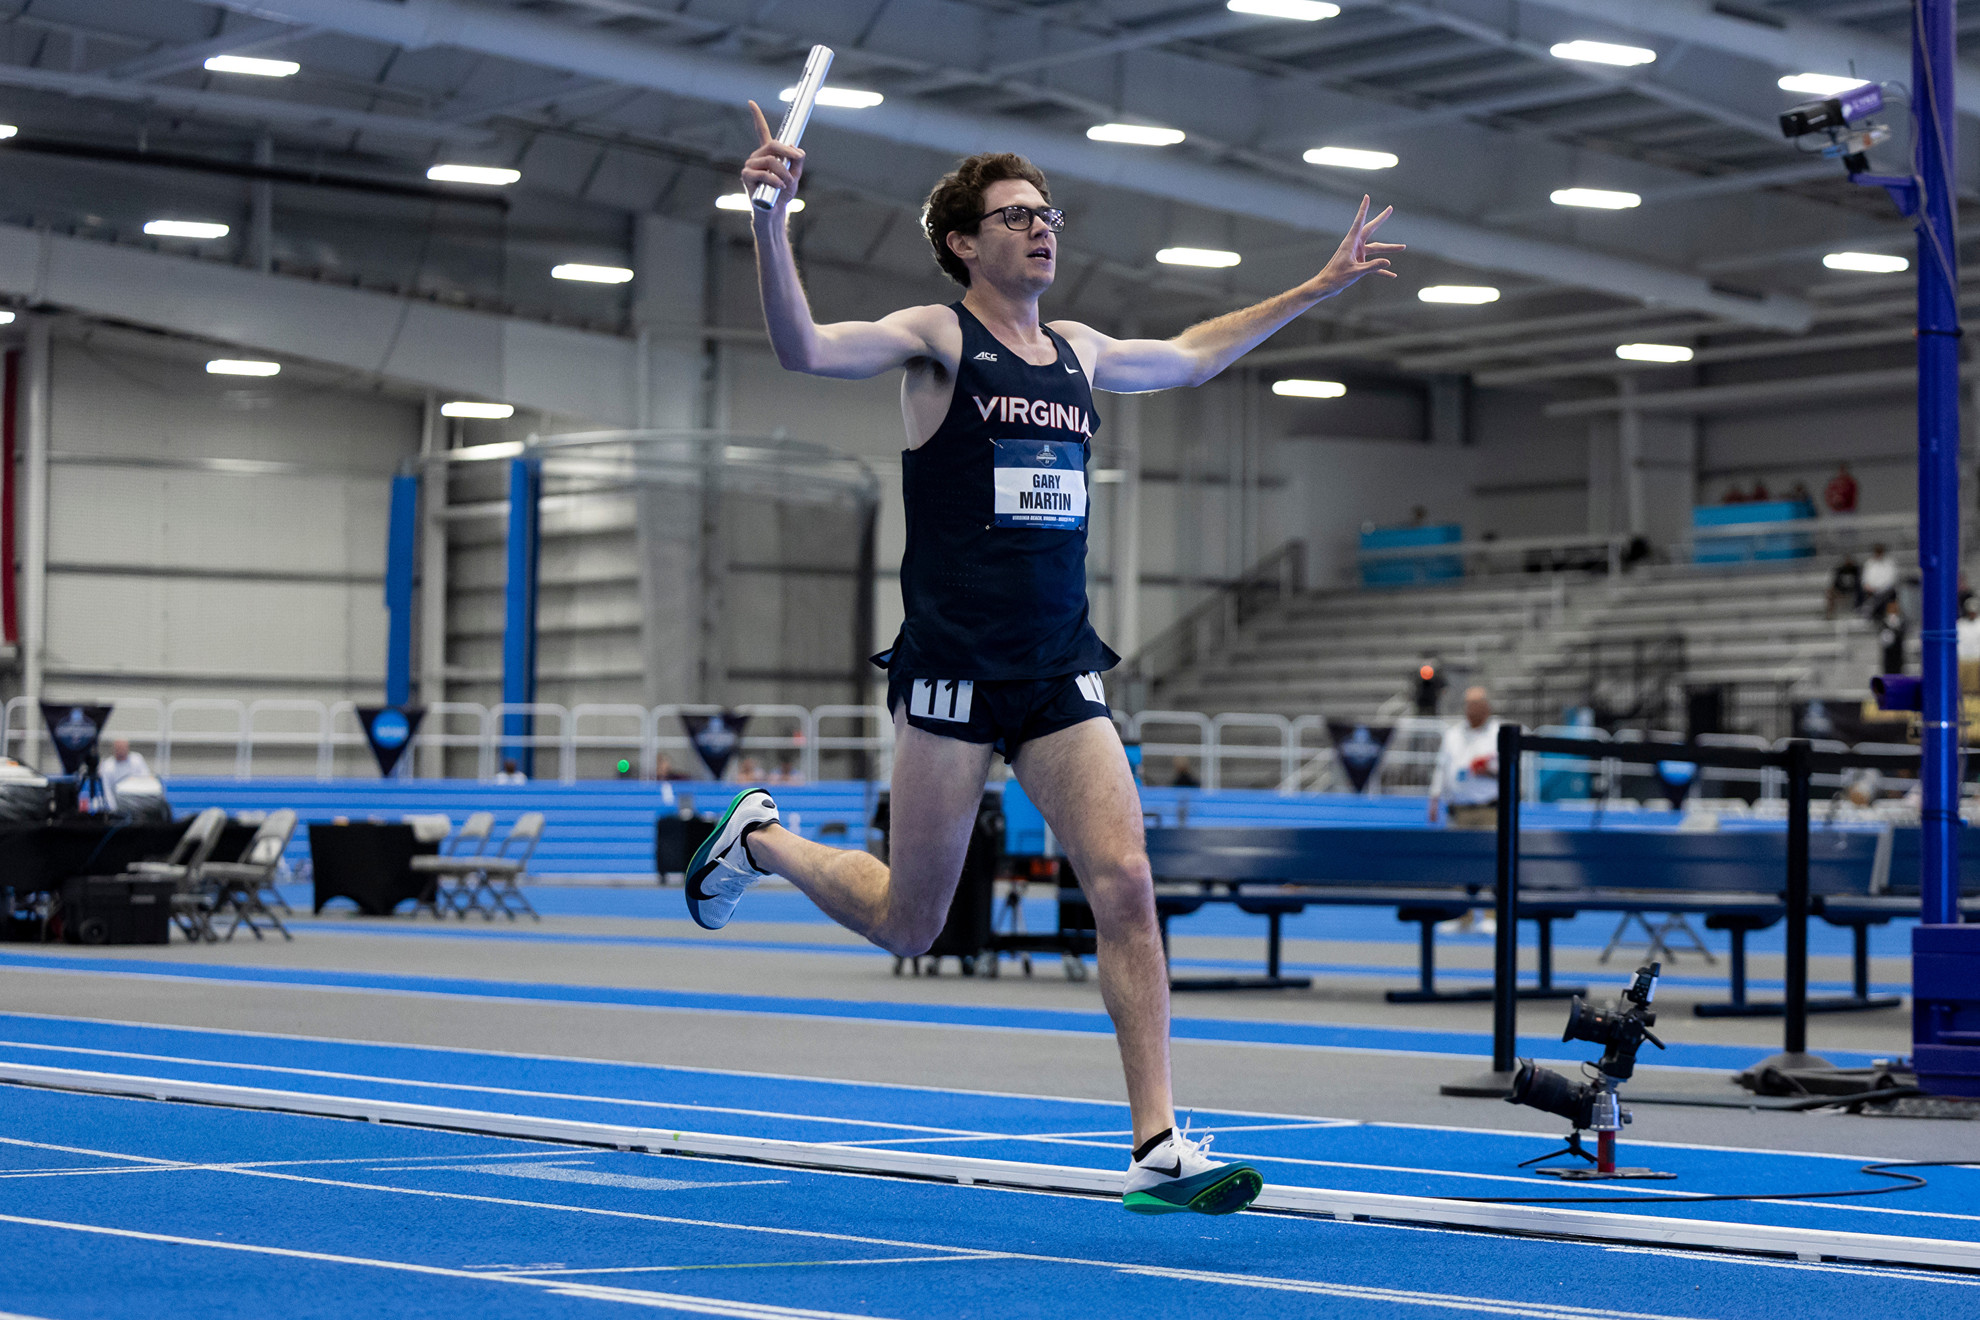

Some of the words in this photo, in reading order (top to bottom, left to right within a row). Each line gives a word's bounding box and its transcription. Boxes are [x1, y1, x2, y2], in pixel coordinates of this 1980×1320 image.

[973, 351, 998, 362] ACC
[972, 396, 1092, 438] VIRGINIA
[1032, 474, 1061, 489] GARY
[1020, 492, 1071, 511] MARTIN
[923, 679, 960, 719] 11
